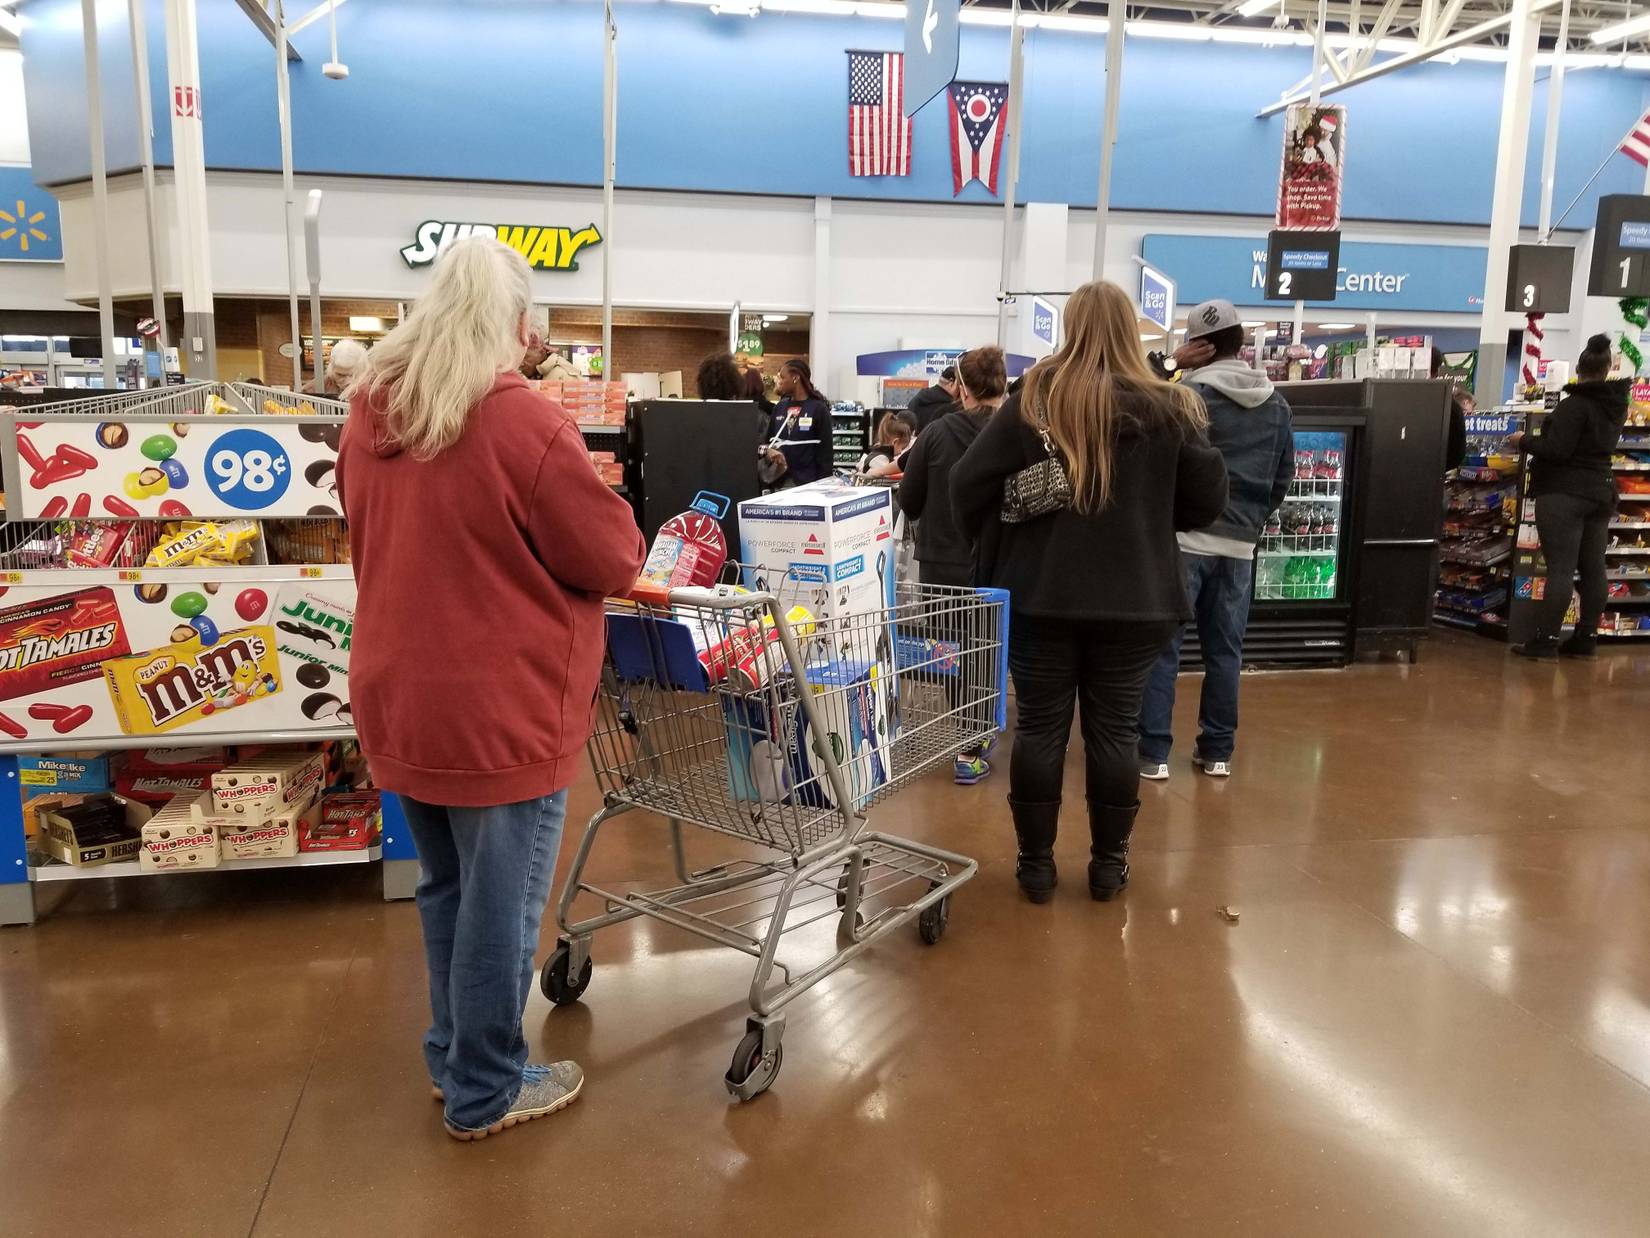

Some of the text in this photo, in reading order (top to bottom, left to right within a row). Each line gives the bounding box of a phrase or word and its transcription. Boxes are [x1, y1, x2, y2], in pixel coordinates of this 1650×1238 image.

[1336, 267, 1405, 293] Center
[1620, 256, 1631, 288] 1
[1278, 272, 1292, 295] 2
[1145, 290, 1165, 301] Scan
[1523, 284, 1535, 307] 3
[1035, 315, 1052, 324] Scan
[1636, 388, 1650, 397] LAYA
[1476, 415, 1509, 431] treats
[747, 539, 796, 549] POWERFORCE
[837, 563, 862, 578] COMPACT
[43, 603, 71, 615] CANDY
[282, 600, 354, 637] Juni
[0, 623, 116, 671] OT TAMALES
[277, 644, 328, 664] Junior
[327, 663, 349, 676] Min
[140, 660, 169, 680] PEANUT
[38, 761, 67, 770] Mike
[217, 784, 276, 799] WHOPPERS
[149, 835, 212, 852] WHOPPERS
[226, 828, 287, 845] WHOPPERS
[111, 840, 141, 858] HERSH
